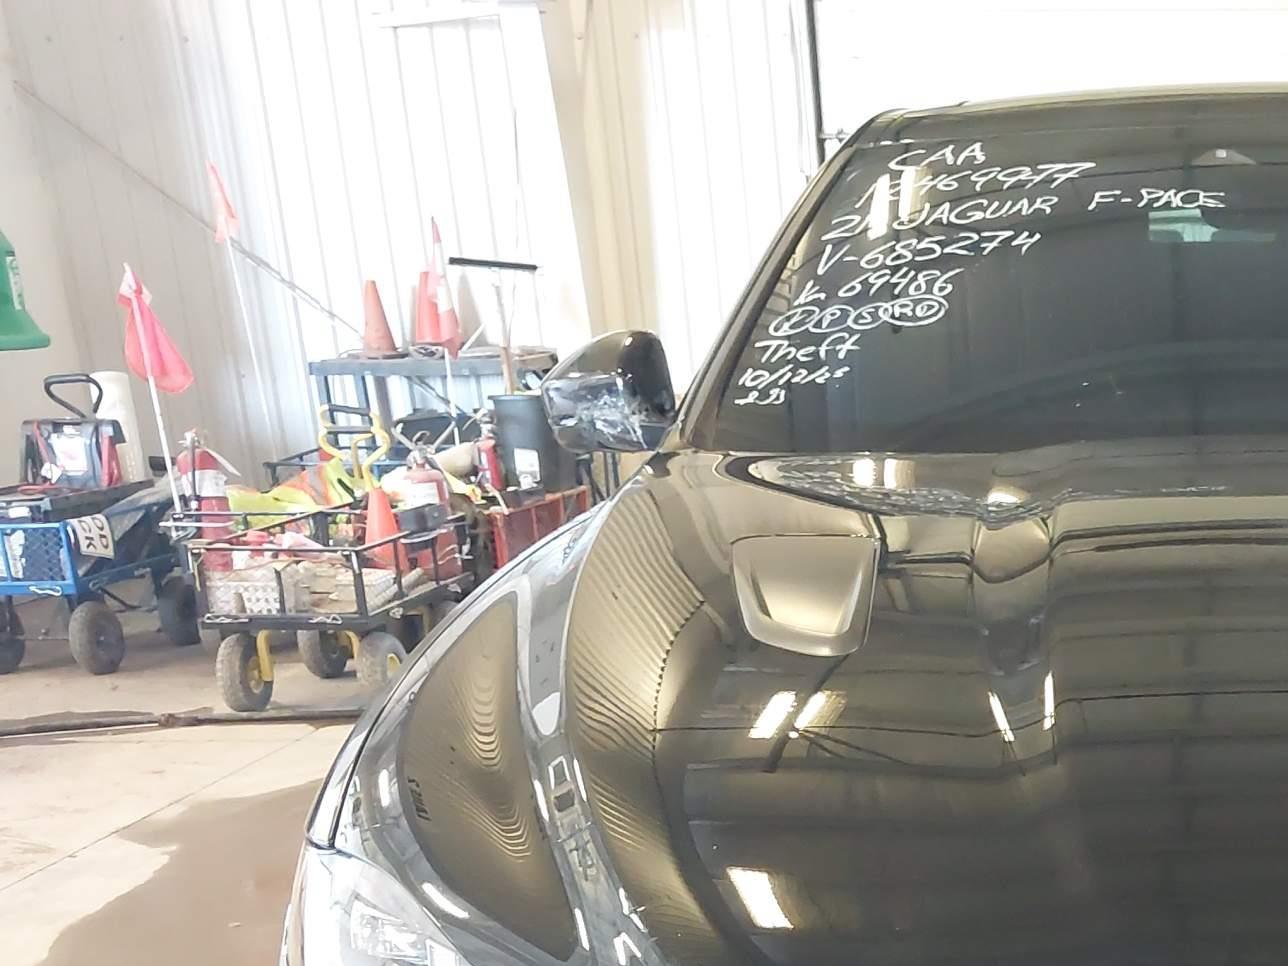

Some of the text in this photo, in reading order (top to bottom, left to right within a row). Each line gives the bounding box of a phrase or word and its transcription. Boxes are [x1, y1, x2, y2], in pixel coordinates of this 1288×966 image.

[892, 196, 1059, 230] JAGUAR
[1087, 188, 1227, 211] F-PACE
[817, 231, 1041, 275] V-685274
[838, 267, 964, 297] 69486
[754, 332, 861, 364] Theft
